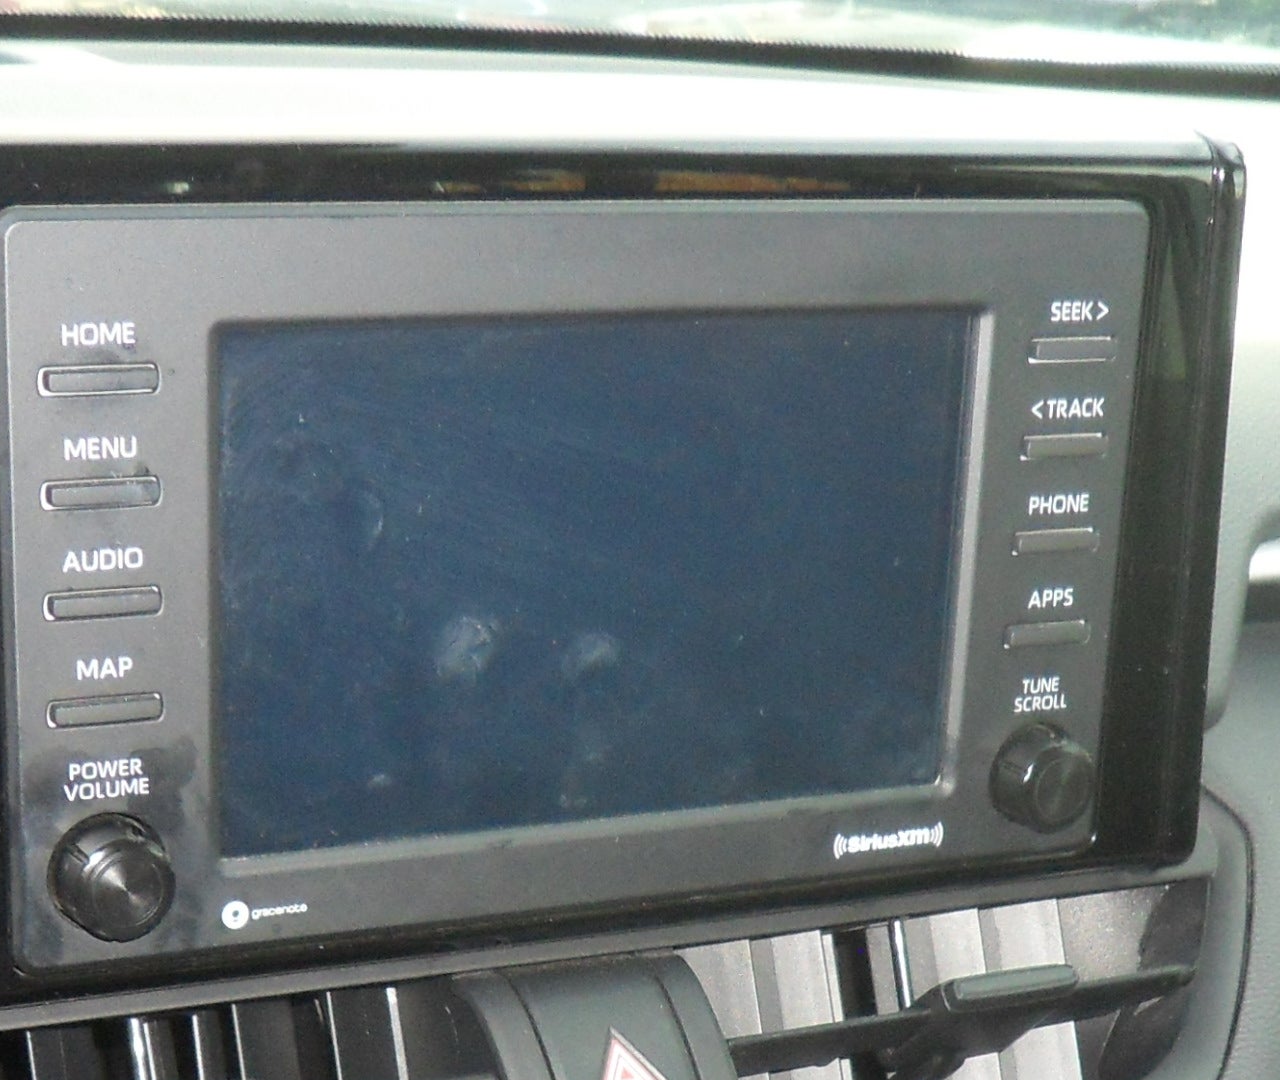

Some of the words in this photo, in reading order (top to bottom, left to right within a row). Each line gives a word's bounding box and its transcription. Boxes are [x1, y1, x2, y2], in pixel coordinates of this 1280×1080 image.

[60, 322, 136, 346] HOME
[63, 436, 137, 460] MENU
[1028, 493, 1090, 516] PHONE
[62, 547, 144, 573] AUDIO
[1028, 588, 1074, 609] APPS
[76, 656, 134, 681] MAP
[1022, 676, 1060, 695] TUNE
[1014, 694, 1067, 713] SCROLL
[68, 757, 143, 782] POWER
[63, 777, 150, 802] VOLUME
